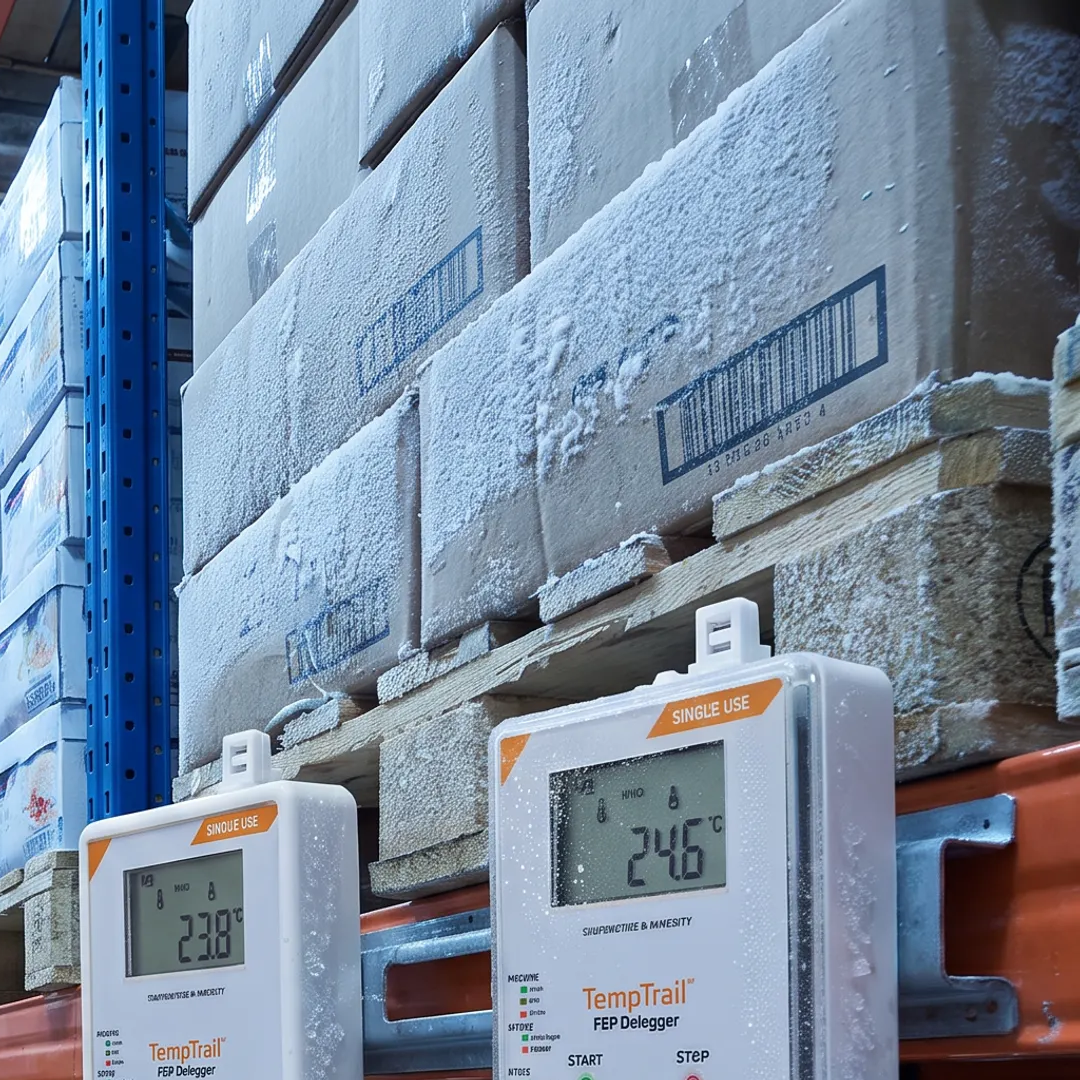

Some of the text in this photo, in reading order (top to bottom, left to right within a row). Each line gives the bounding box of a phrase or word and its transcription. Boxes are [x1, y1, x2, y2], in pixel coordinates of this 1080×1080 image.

[672, 694, 750, 725] SINGLE USE
[241, 815, 259, 829] USE
[582, 978, 686, 1013] TempTrail
[593, 1014, 680, 1032] FEP Delegger
[148, 1037, 221, 1065] TempTrail
[568, 1053, 603, 1067] START
[176, 1064, 216, 1079] Delegger
